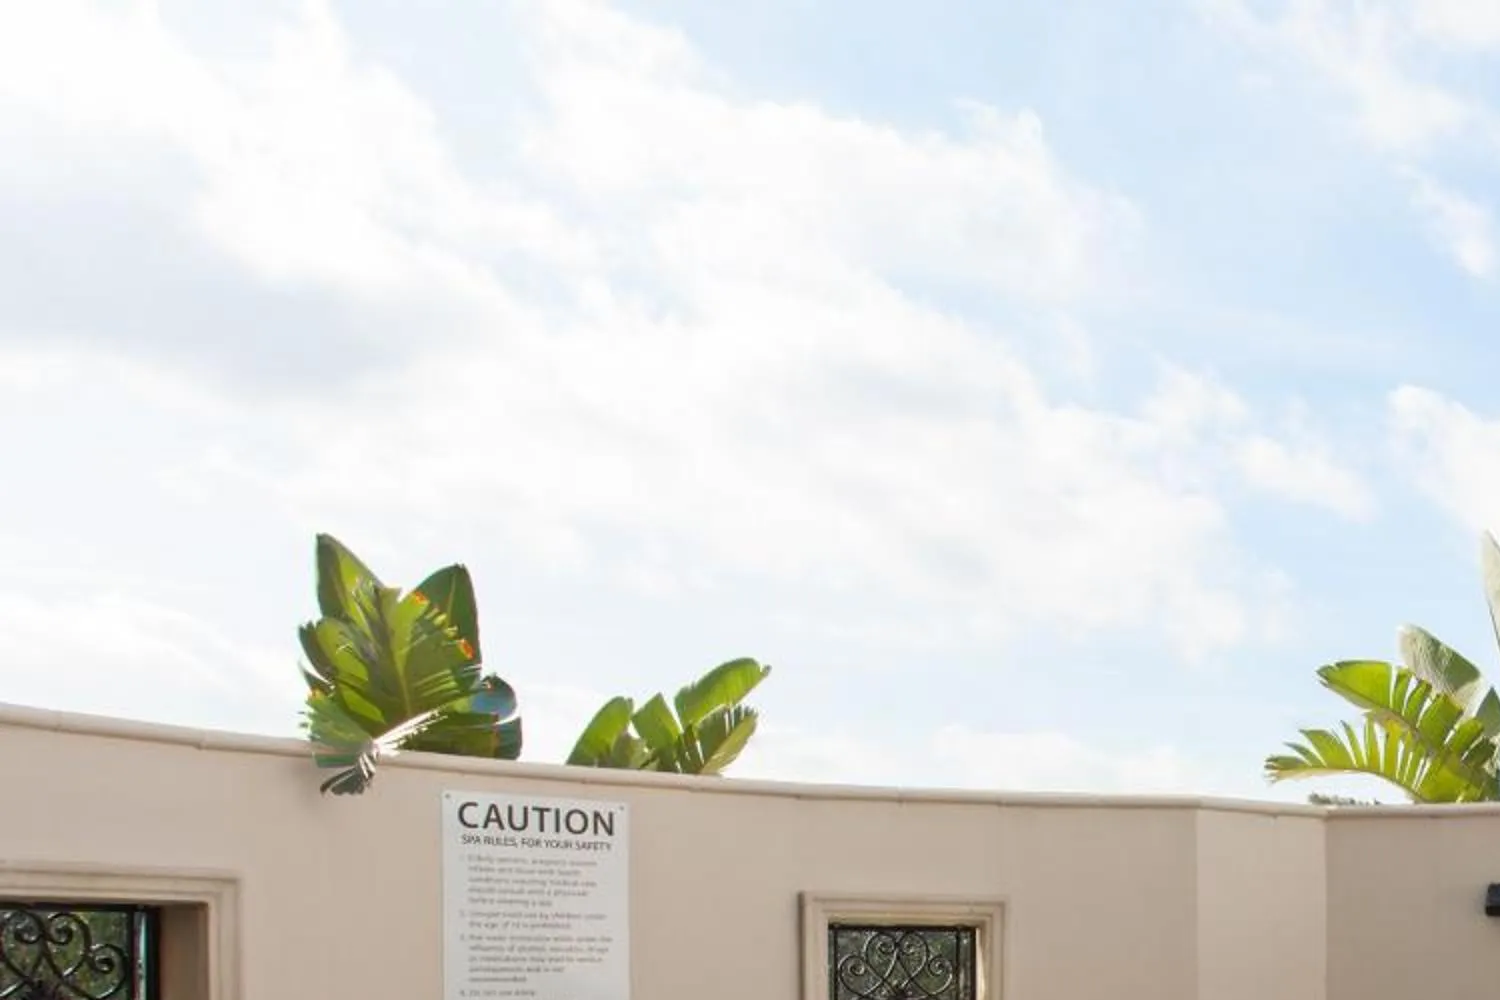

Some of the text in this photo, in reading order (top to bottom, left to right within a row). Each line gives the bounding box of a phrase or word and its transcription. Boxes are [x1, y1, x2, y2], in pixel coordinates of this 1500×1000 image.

[458, 802, 614, 836] CAUTION
[462, 834, 611, 851] SPA RULES, FOR YOUR SAFETY
